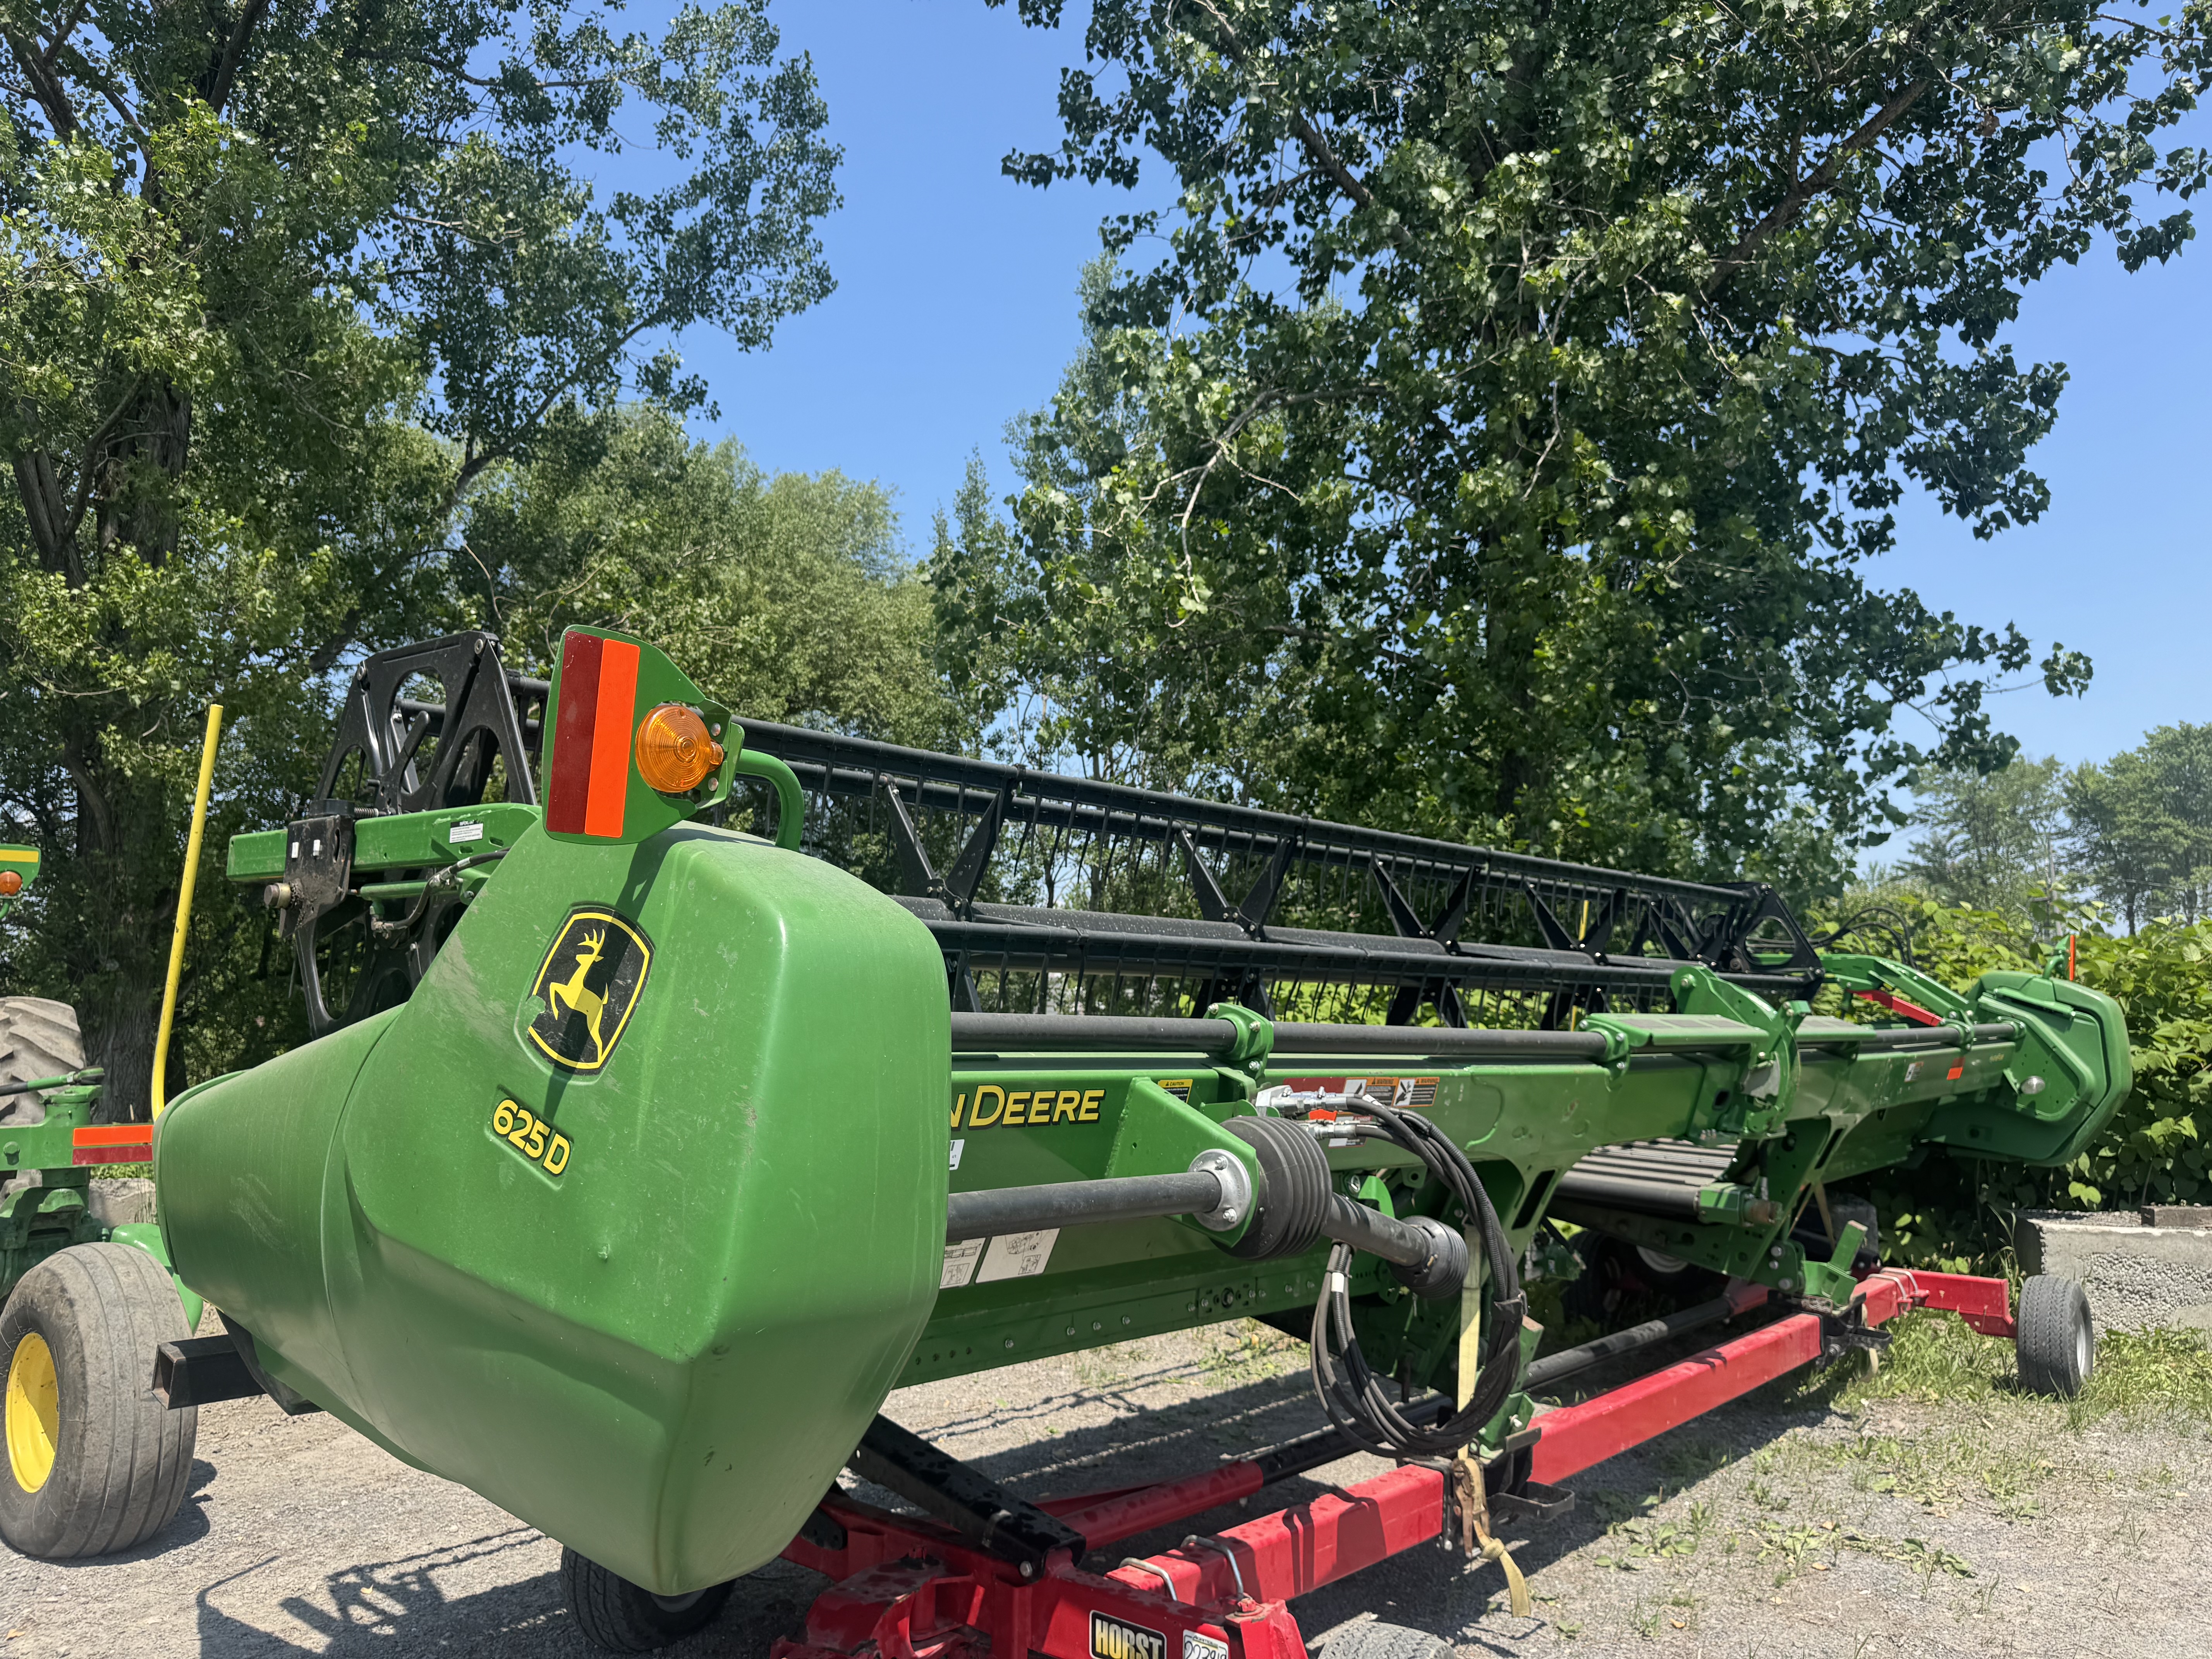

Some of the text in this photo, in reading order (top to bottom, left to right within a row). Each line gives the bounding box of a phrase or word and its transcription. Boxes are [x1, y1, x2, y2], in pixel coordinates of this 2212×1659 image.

[968, 1085, 1105, 1127] DEERE
[493, 1099, 570, 1175] 625D
[1095, 1618, 1163, 1659] HORST
